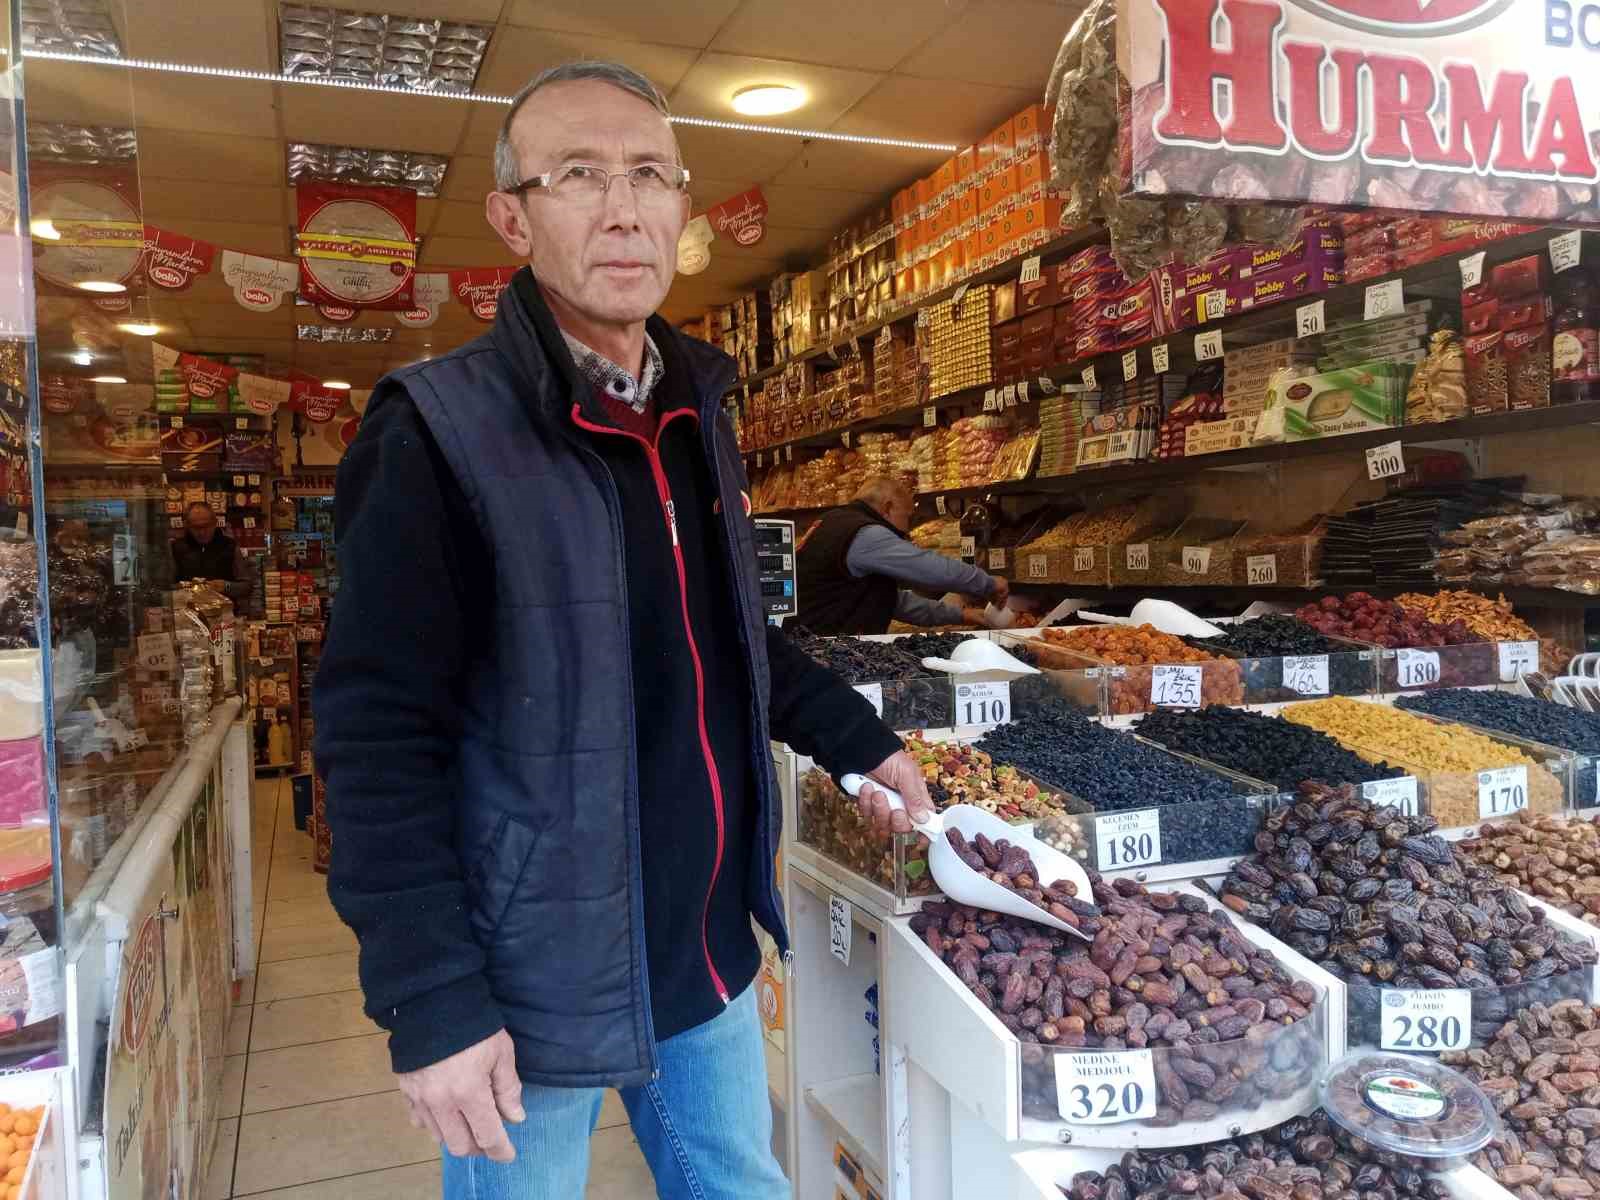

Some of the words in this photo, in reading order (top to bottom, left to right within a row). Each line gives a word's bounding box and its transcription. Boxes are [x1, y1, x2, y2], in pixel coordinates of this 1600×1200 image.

[1153, 0, 1600, 183] HURMA
[1253, 250, 1283, 266] hobby
[155, 270, 180, 284] balin
[1186, 271, 1213, 288] hobby
[245, 289, 270, 303] balin
[1163, 278, 1172, 306] Piko
[1255, 281, 1285, 297] hobby
[1302, 316, 1318, 335] 50
[1201, 343, 1217, 359] 30
[1371, 455, 1399, 478] 300
[1077, 557, 1093, 569] 180
[1129, 554, 1147, 569] 260
[1188, 557, 1202, 572] 90
[1251, 566, 1273, 583] 260
[1404, 662, 1436, 684] 180
[964, 699, 1005, 724] 110
[1490, 784, 1524, 813] 170
[1107, 832, 1153, 865] 180
[1392, 1015, 1461, 1048] 280
[1070, 1081, 1144, 1119] 320
